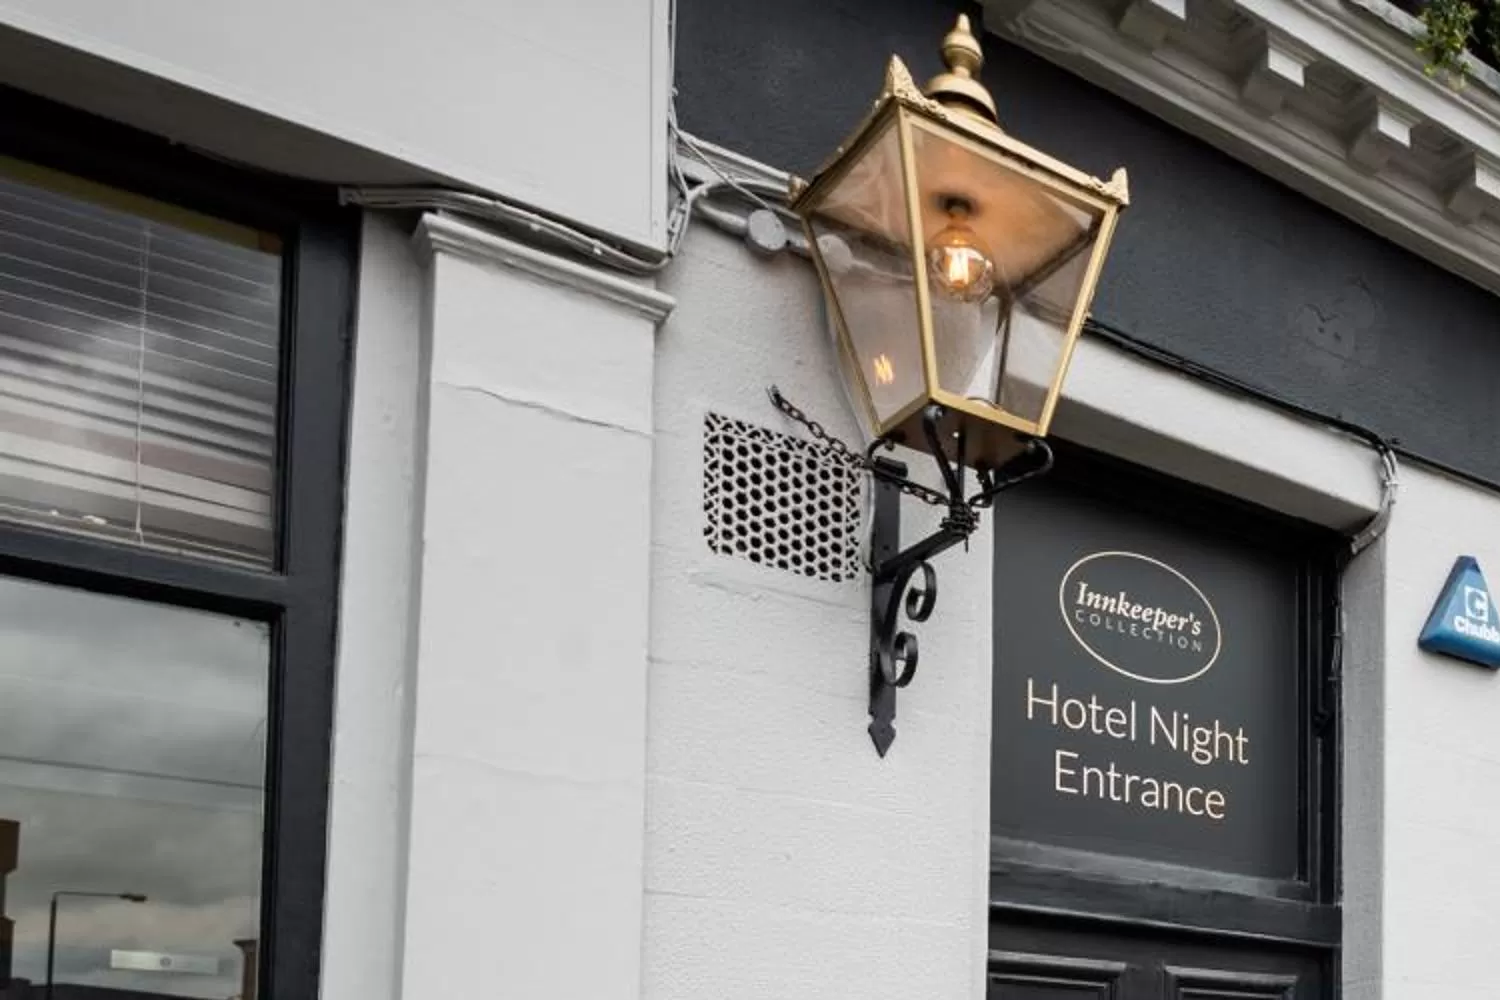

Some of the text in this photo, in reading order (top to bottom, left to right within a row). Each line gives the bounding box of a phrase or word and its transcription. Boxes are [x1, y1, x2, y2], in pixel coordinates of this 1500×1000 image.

[1075, 609, 1202, 653] COLLECTION
[1076, 580, 1202, 636] Innkeeper's
[1453, 614, 1500, 644] Chubb
[1025, 677, 1249, 766] Hotel Night
[1054, 748, 1226, 820] Entrance
